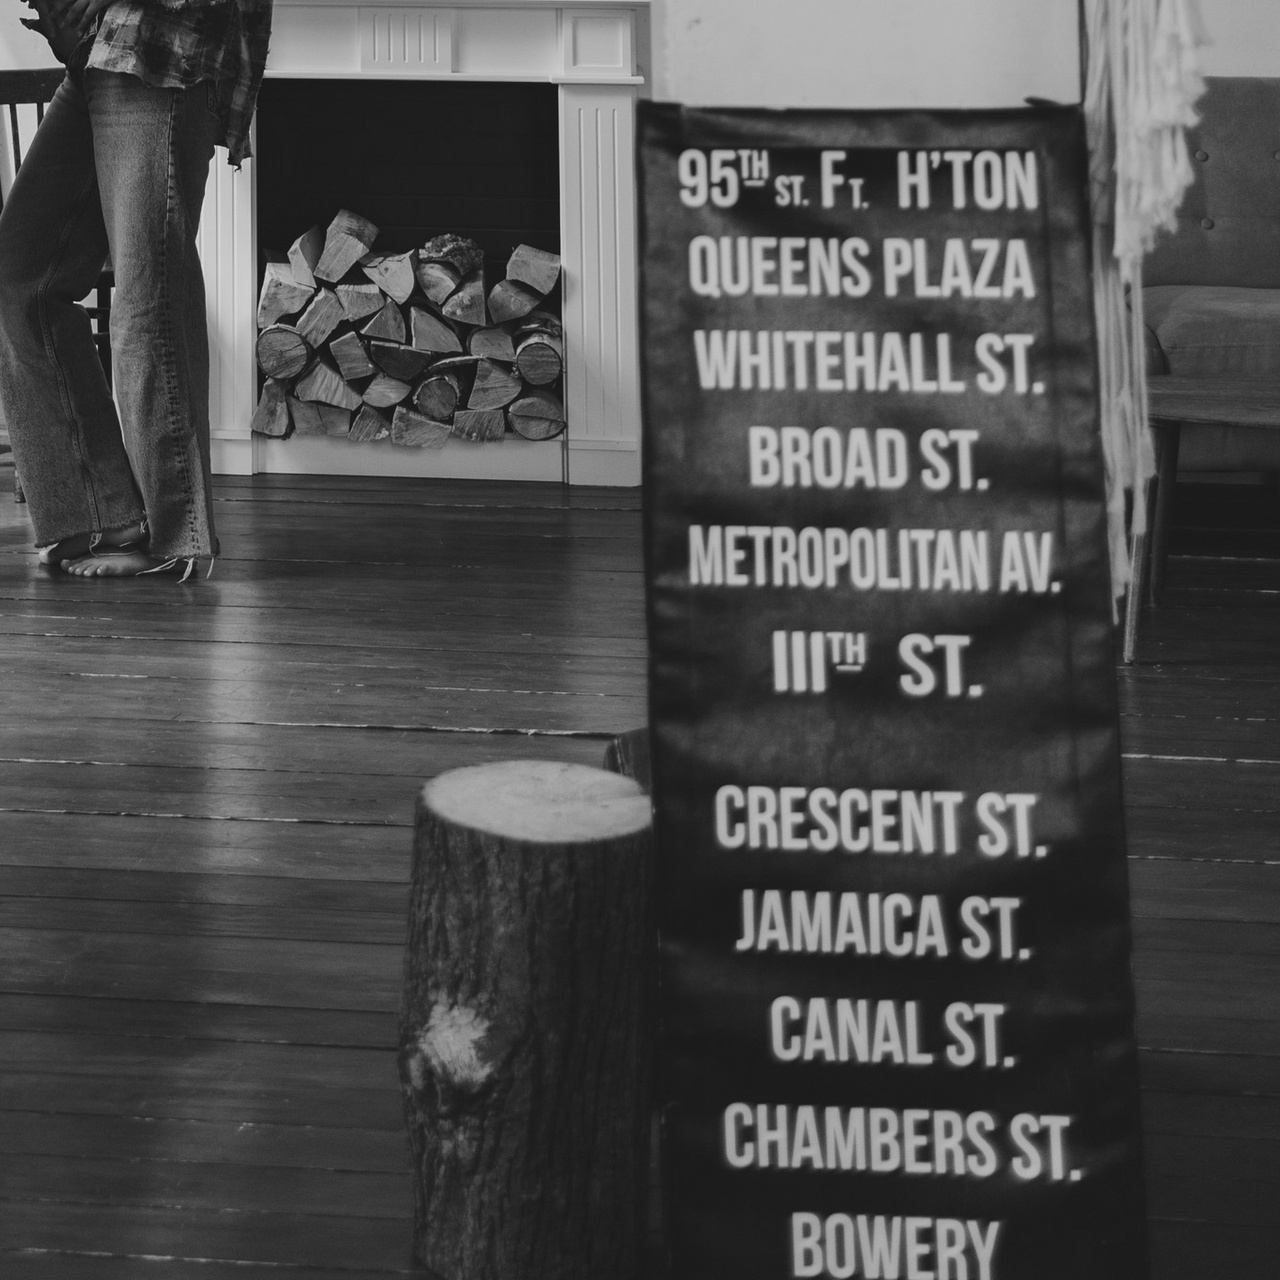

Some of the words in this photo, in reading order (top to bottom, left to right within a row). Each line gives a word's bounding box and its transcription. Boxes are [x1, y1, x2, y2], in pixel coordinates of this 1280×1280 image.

[775, 176, 809, 206] ST.
[898, 151, 1038, 209] H'TON
[689, 235, 871, 298] QUEENS
[883, 238, 1036, 298] PLAZA
[694, 329, 965, 392] WHITEHALL
[974, 334, 1045, 394] ST.
[747, 425, 908, 490] BROAD
[920, 429, 989, 491] ST.
[689, 525, 989, 591] METROPOLITAN
[1000, 530, 1061, 593] AV.
[899, 634, 983, 697] ST.
[716, 785, 965, 855] CRESCENT
[976, 792, 1047, 857] ST.
[736, 890, 948, 956] JAMAICA
[961, 896, 1030, 959] ST.
[771, 996, 933, 1064] CANAL
[945, 1002, 1014, 1067] ST.
[725, 1103, 997, 1177] CHAMBERS
[1010, 1114, 1081, 1181] ST.
[792, 1213, 999, 1280] BOWERY
